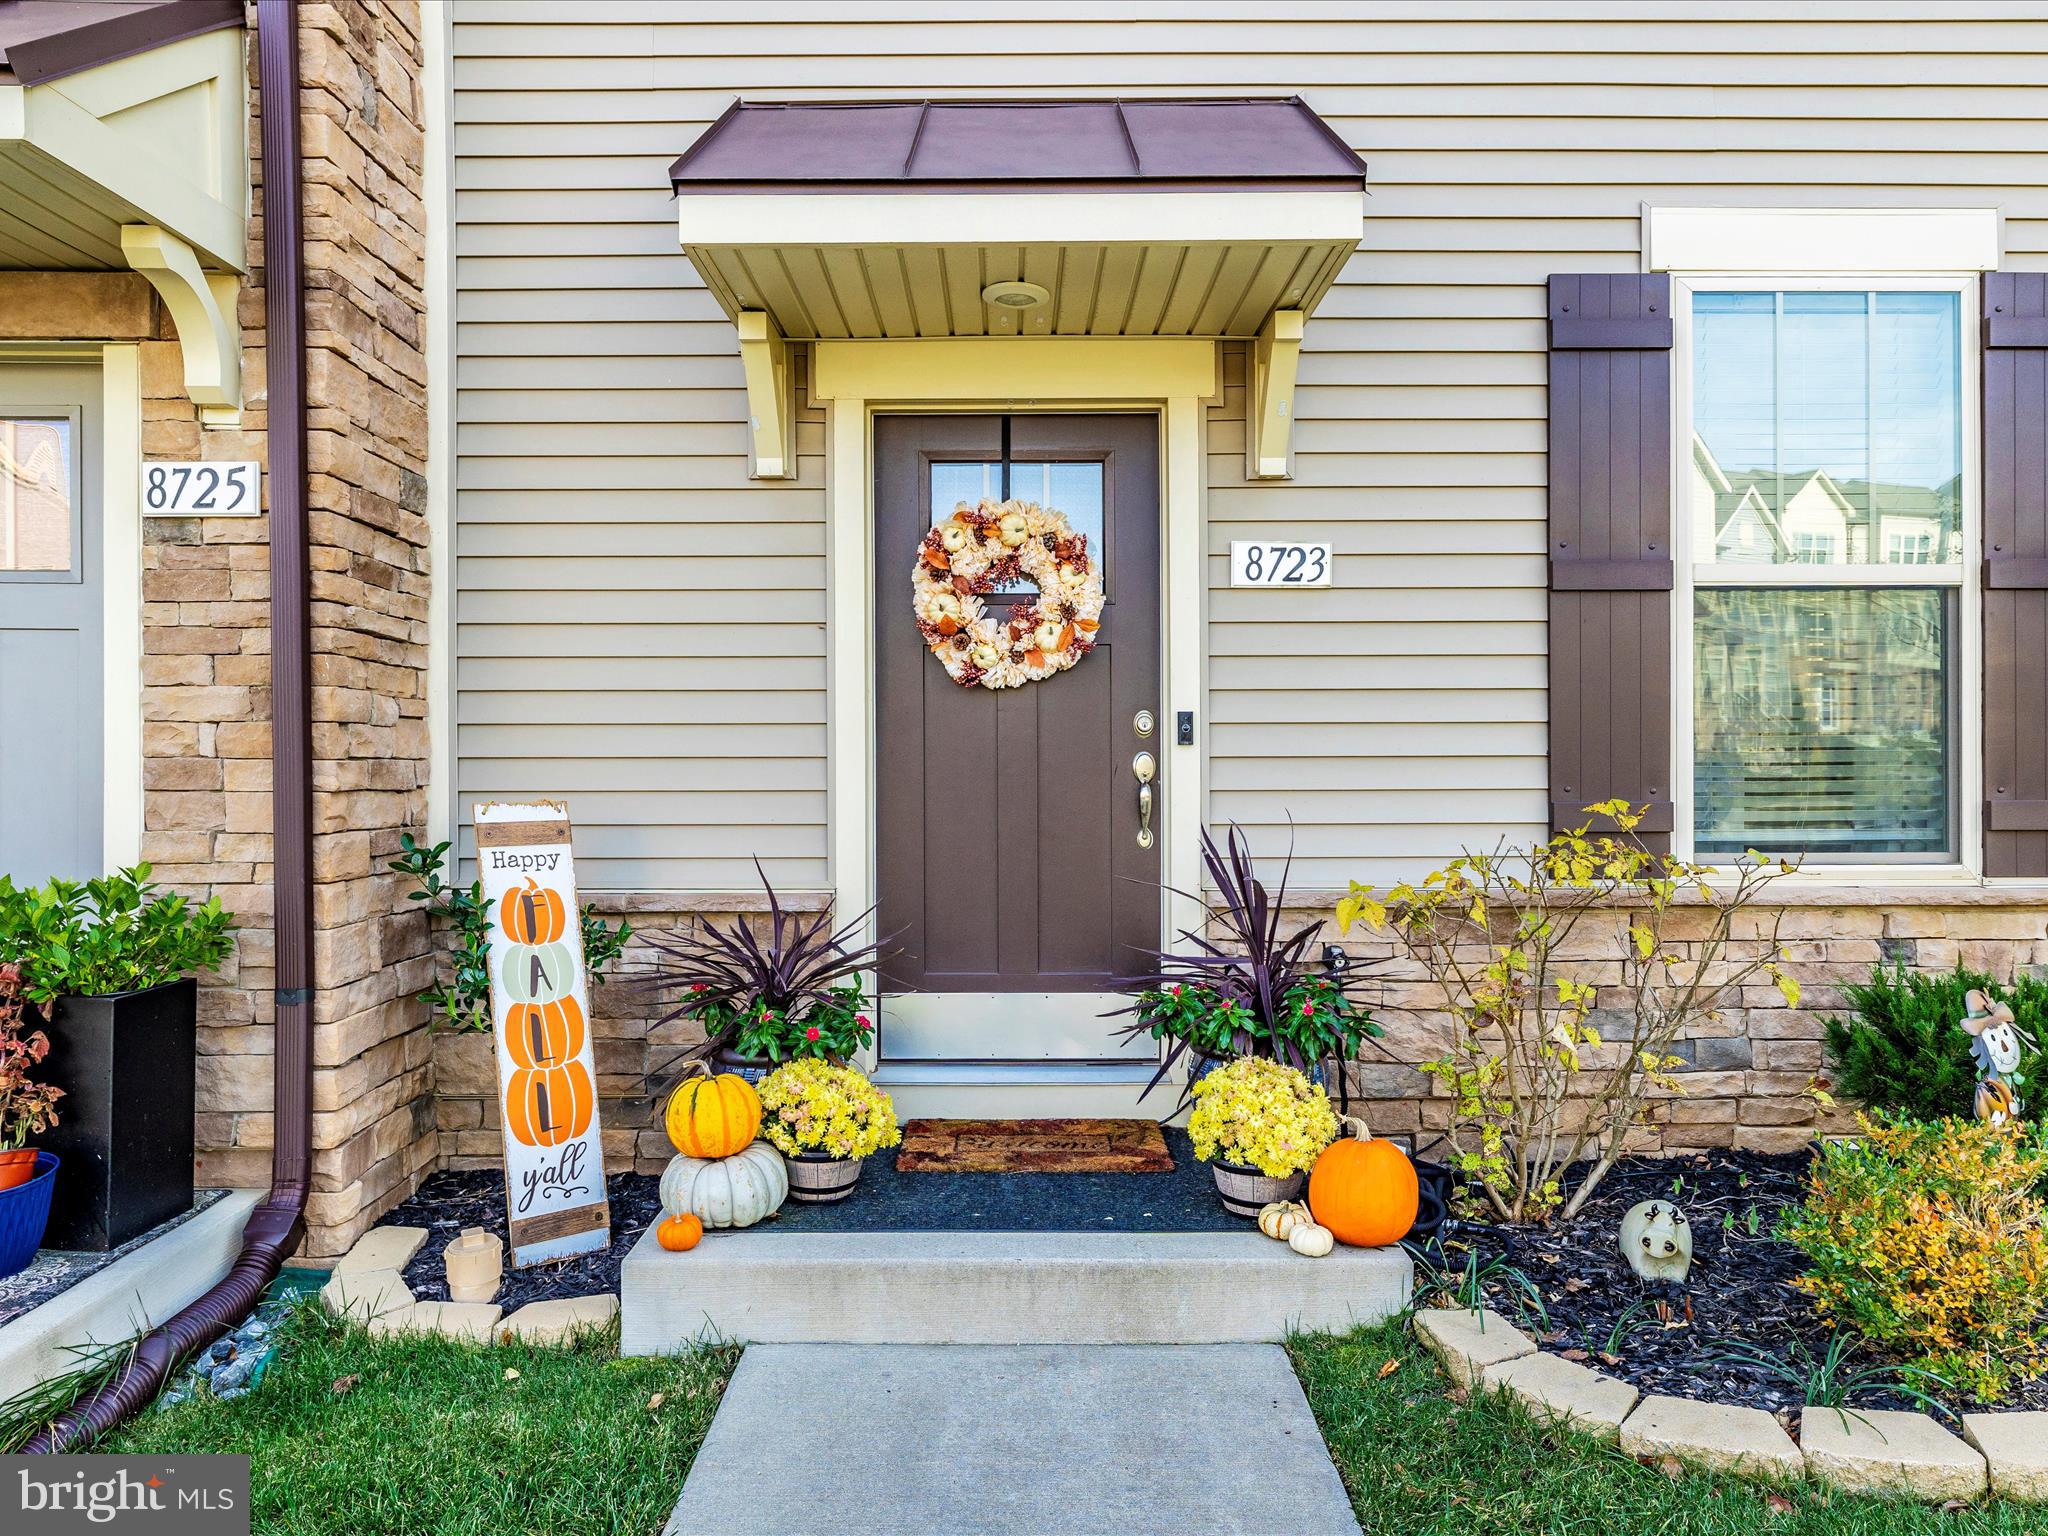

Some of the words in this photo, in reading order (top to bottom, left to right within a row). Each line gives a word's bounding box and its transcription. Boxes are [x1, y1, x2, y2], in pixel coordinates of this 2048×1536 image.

[147, 466, 246, 510] 8725
[1245, 546, 1326, 582] 8723
[492, 851, 560, 872] Happy
[521, 894, 562, 1133] FALL
[518, 1141, 587, 1213] y'all
